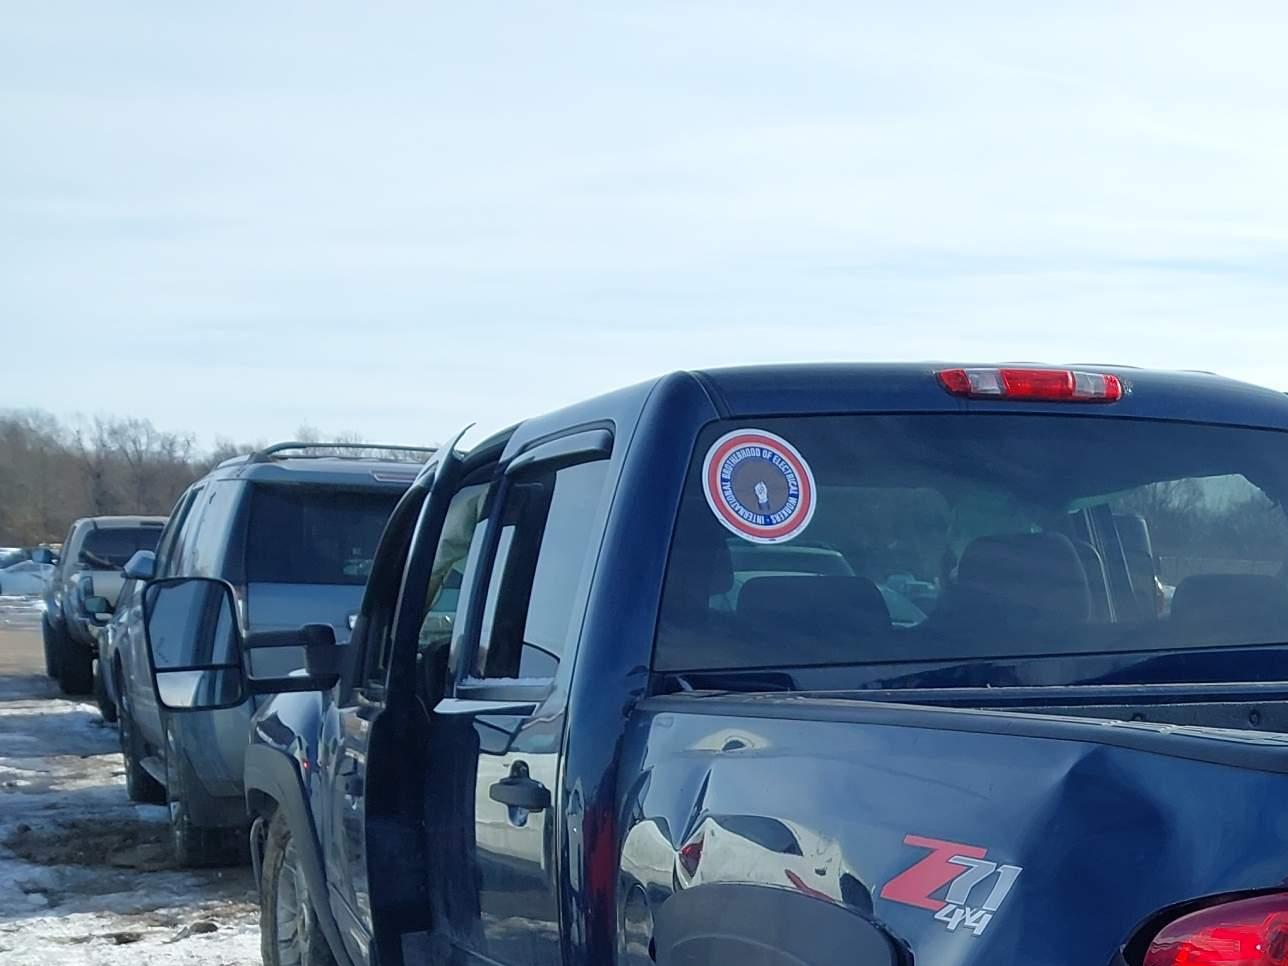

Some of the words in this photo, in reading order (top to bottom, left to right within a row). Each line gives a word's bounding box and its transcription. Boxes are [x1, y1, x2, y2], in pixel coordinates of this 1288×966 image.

[721, 447, 761, 481] BROTHERHOOD
[762, 449, 773, 459] OF
[772, 455, 798, 497] ELECTRICAL
[721, 480, 765, 525] INTERNATIONAL
[772, 497, 798, 524] WORKERS
[879, 834, 1023, 912] Z71
